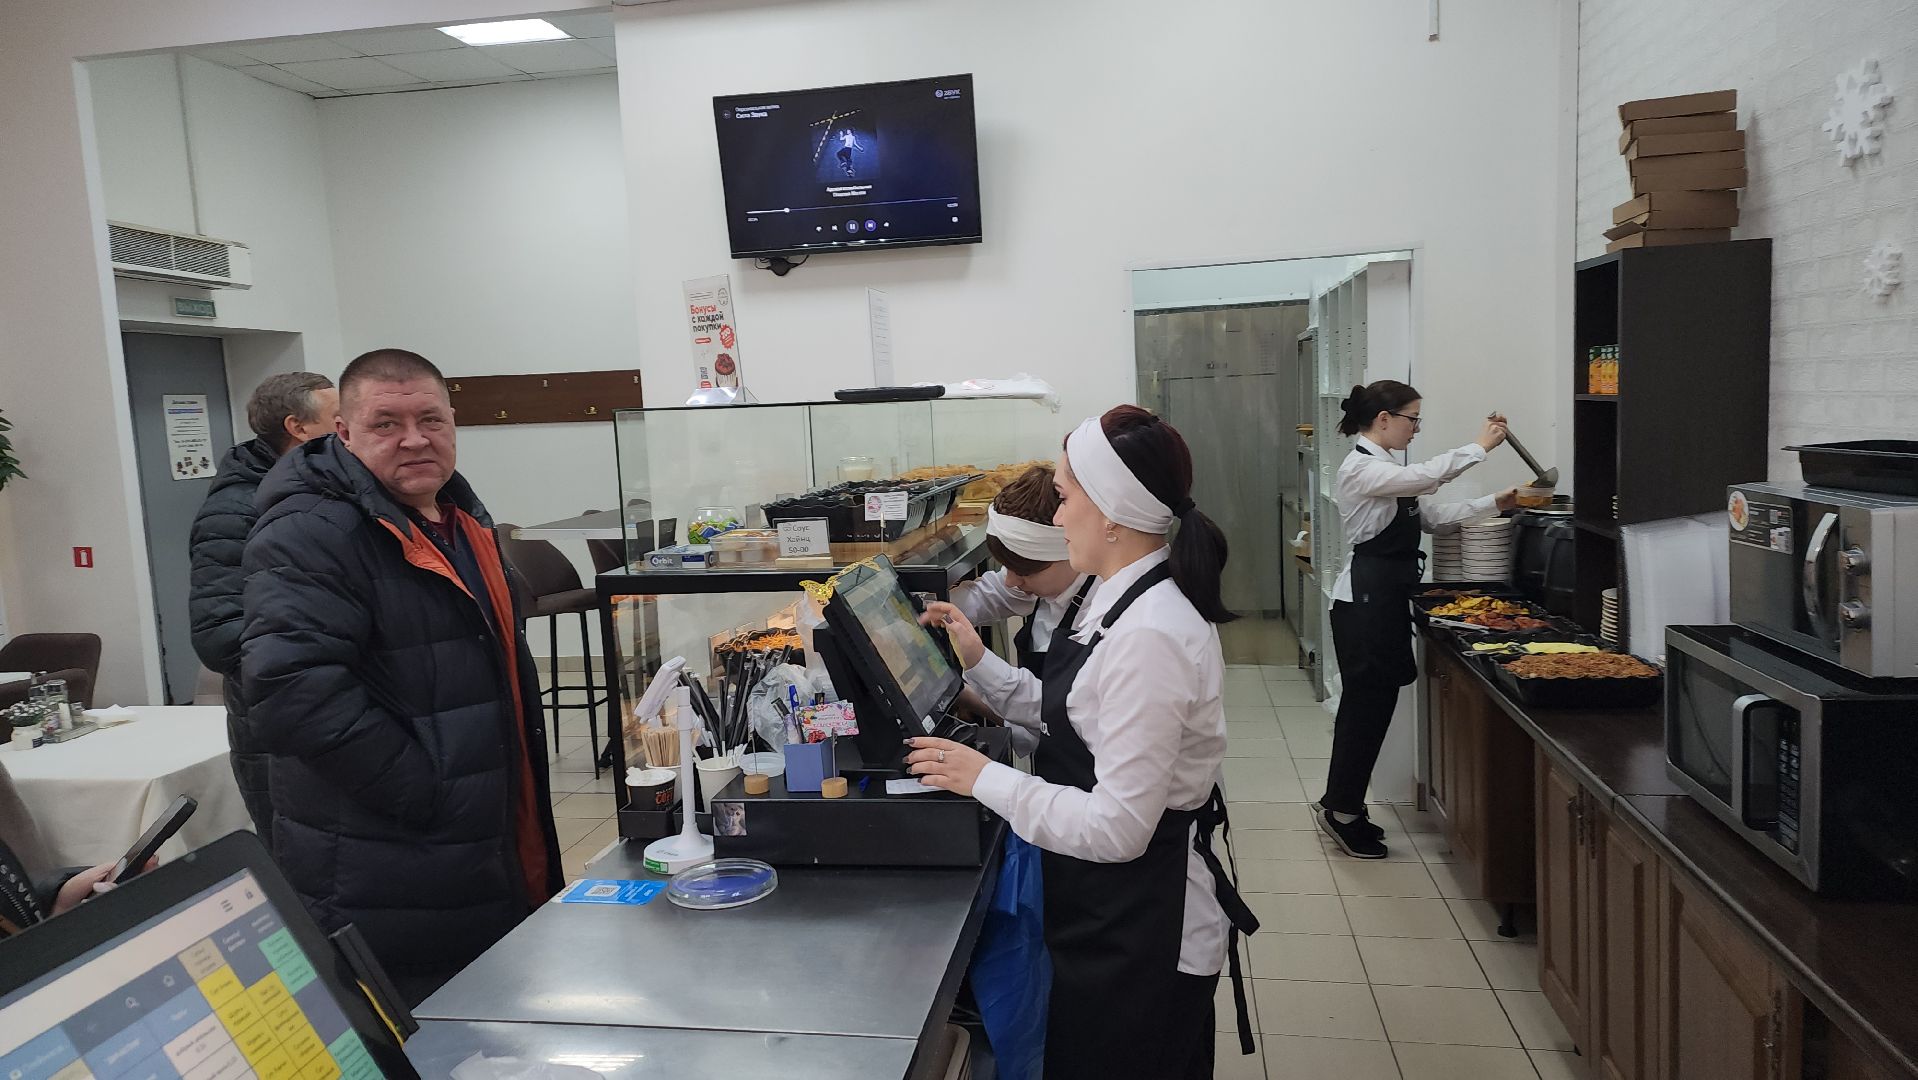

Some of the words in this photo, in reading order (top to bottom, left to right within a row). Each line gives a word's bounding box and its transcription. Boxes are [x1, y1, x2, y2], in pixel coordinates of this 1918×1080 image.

[690, 304, 717, 315] Бонусы
[697, 311, 725, 323] каждой
[692, 323, 722, 333] покупки
[651, 557, 673, 565] Orbit
